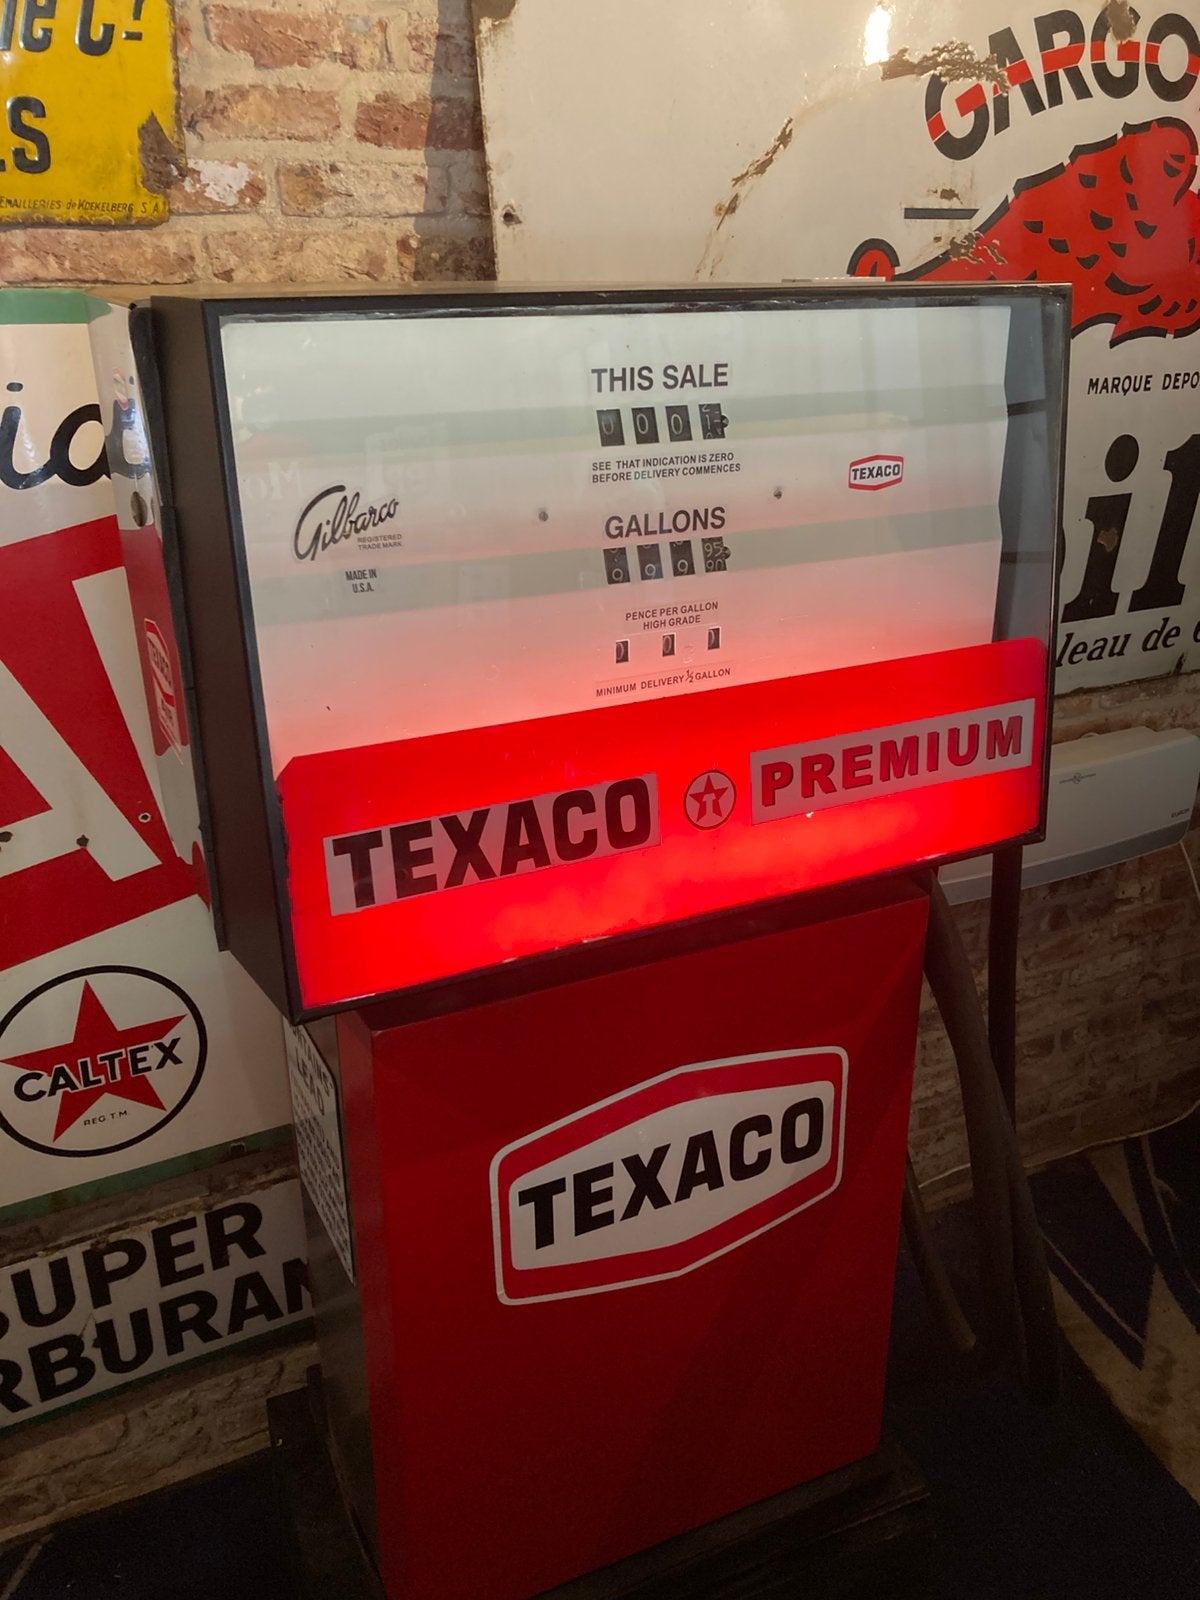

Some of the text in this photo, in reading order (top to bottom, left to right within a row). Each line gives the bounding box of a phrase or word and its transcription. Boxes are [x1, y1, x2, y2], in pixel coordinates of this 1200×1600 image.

[591, 363, 729, 392] THIS SALE
[1088, 374, 1152, 395] MARQUE
[592, 451, 734, 472] SEE THAT INDICATION IS ZERO
[592, 463, 741, 483] BEFORE DELIVERY COMMENCES
[852, 464, 900, 480] TEXACO
[294, 485, 399, 561] Gilbarco
[605, 506, 726, 539] GALLONS
[357, 534, 402, 543] REGISTERED
[345, 568, 378, 580] MADE IN
[625, 601, 719, 622] PENCE PER GALLON
[643, 615, 701, 630] HIGH GRADE
[1141, 616, 1181, 652] de
[596, 682, 637, 697] MINIMUM
[640, 675, 684, 690] DELIVERY
[695, 667, 731, 681] GALLON
[332, 776, 653, 909] TEXACO
[760, 715, 1024, 807] PREMIUM
[13, 1037, 183, 1102] CALTEX
[518, 1097, 824, 1250] TEXACO
[0, 1202, 266, 1342] UPER
